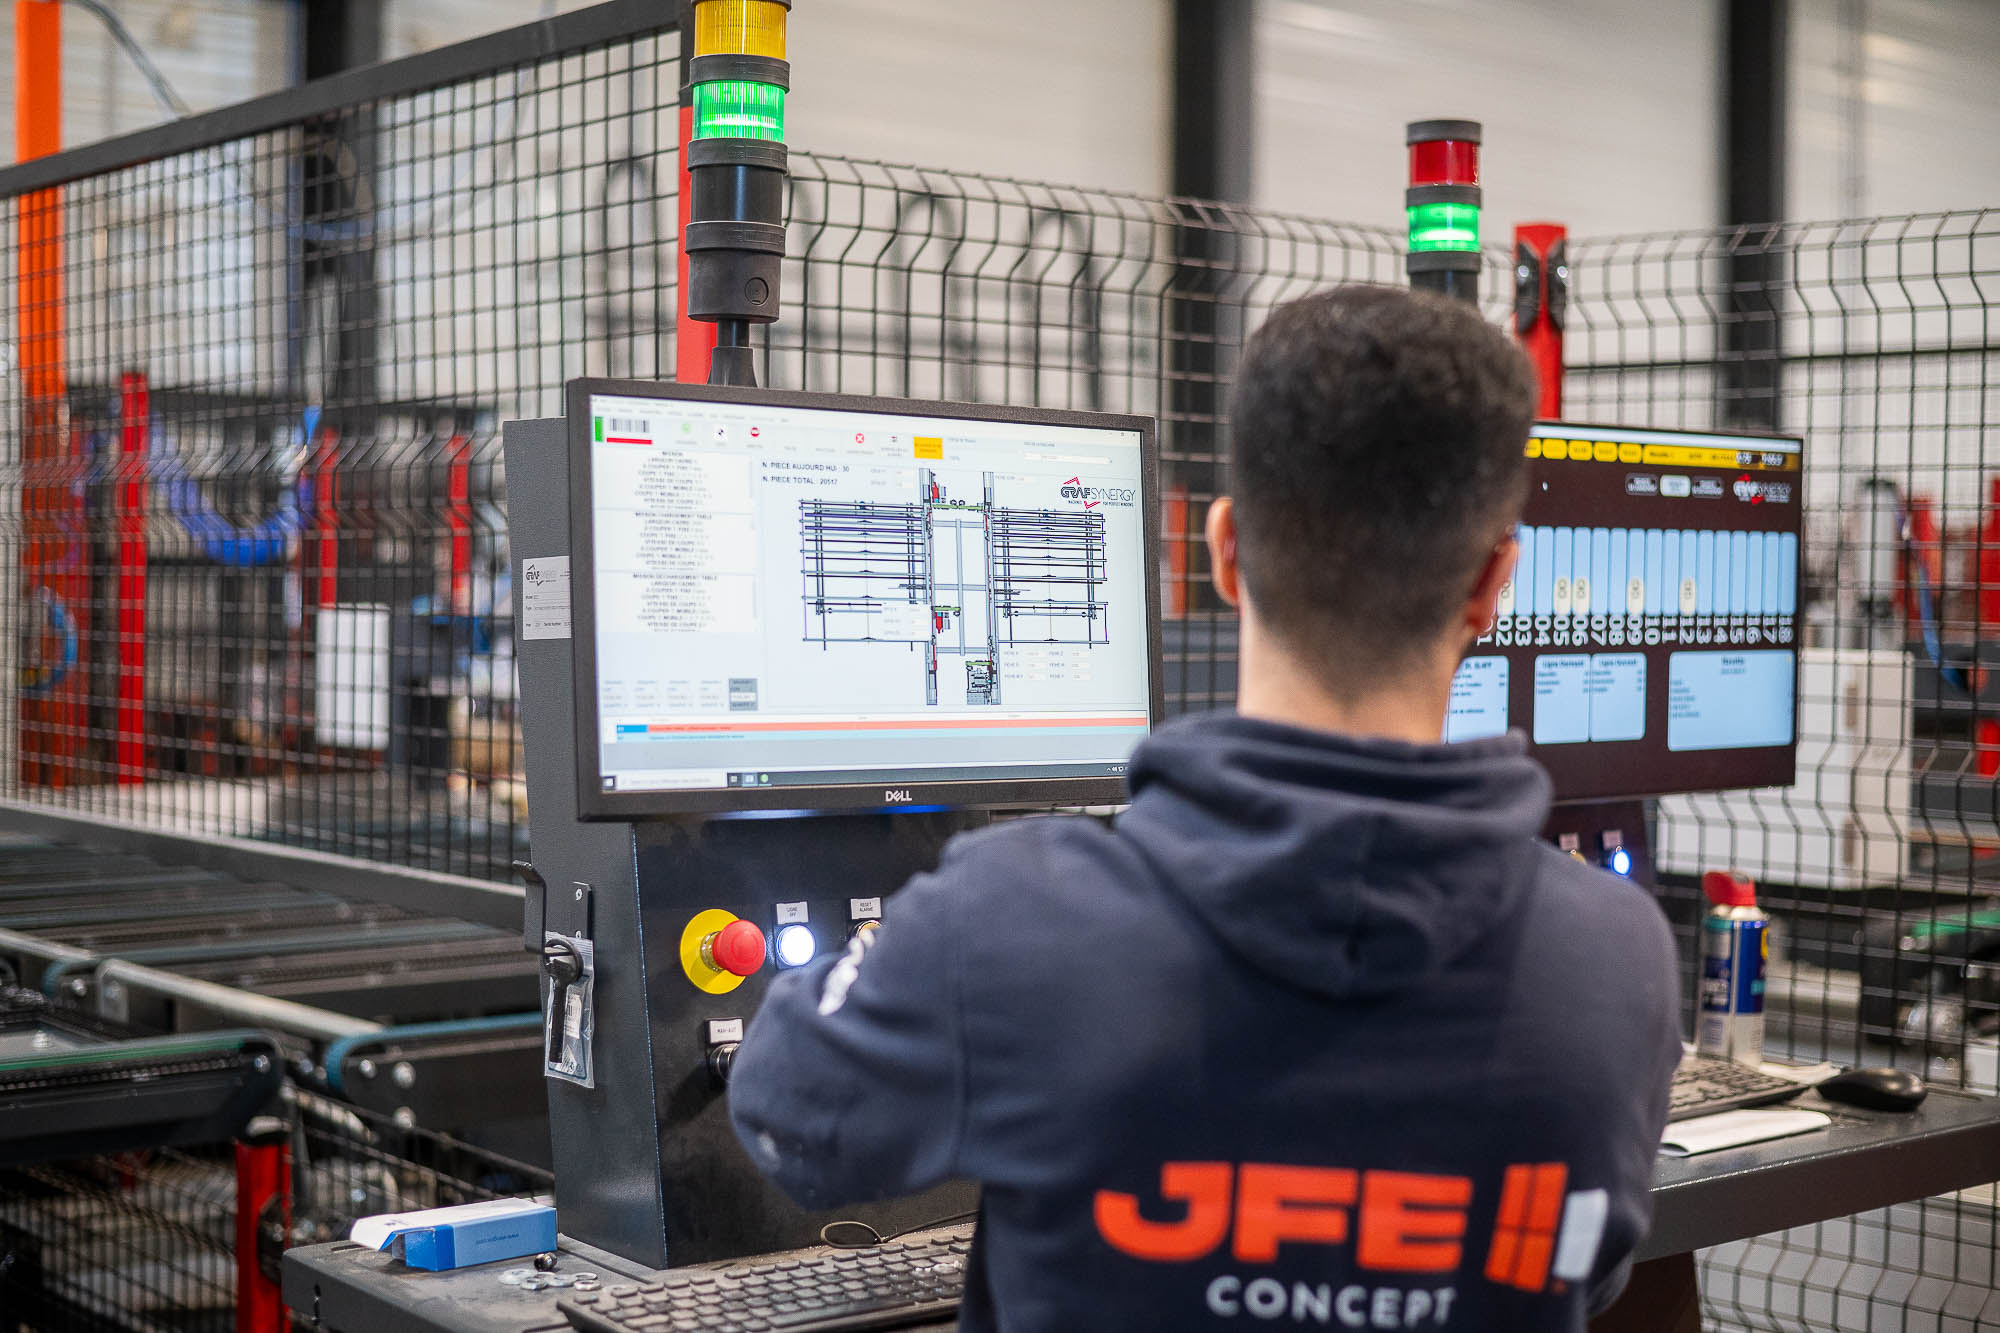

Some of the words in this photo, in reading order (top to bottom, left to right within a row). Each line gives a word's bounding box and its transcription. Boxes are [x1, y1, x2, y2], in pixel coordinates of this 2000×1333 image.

[1496, 616, 1513, 647] 02
[1515, 616, 1532, 646] 03
[1534, 616, 1551, 647] 04
[1554, 616, 1570, 646] 05
[1572, 616, 1589, 646] 06
[1591, 616, 1607, 646] 07
[1609, 615, 1625, 646] 08
[1626, 615, 1643, 646] 09
[1645, 616, 1661, 646] 10
[1662, 616, 1678, 644] 11
[1680, 616, 1695, 645] 12
[1697, 616, 1712, 644] 13
[1713, 616, 1728, 644] 14
[1730, 616, 1745, 644] 15
[1746, 616, 1762, 644] 16
[1763, 616, 1778, 644] 17
[885, 790, 912, 802] DELL
[1093, 1161, 1474, 1273] JFE
[1205, 1274, 1458, 1328] CONCEPT
